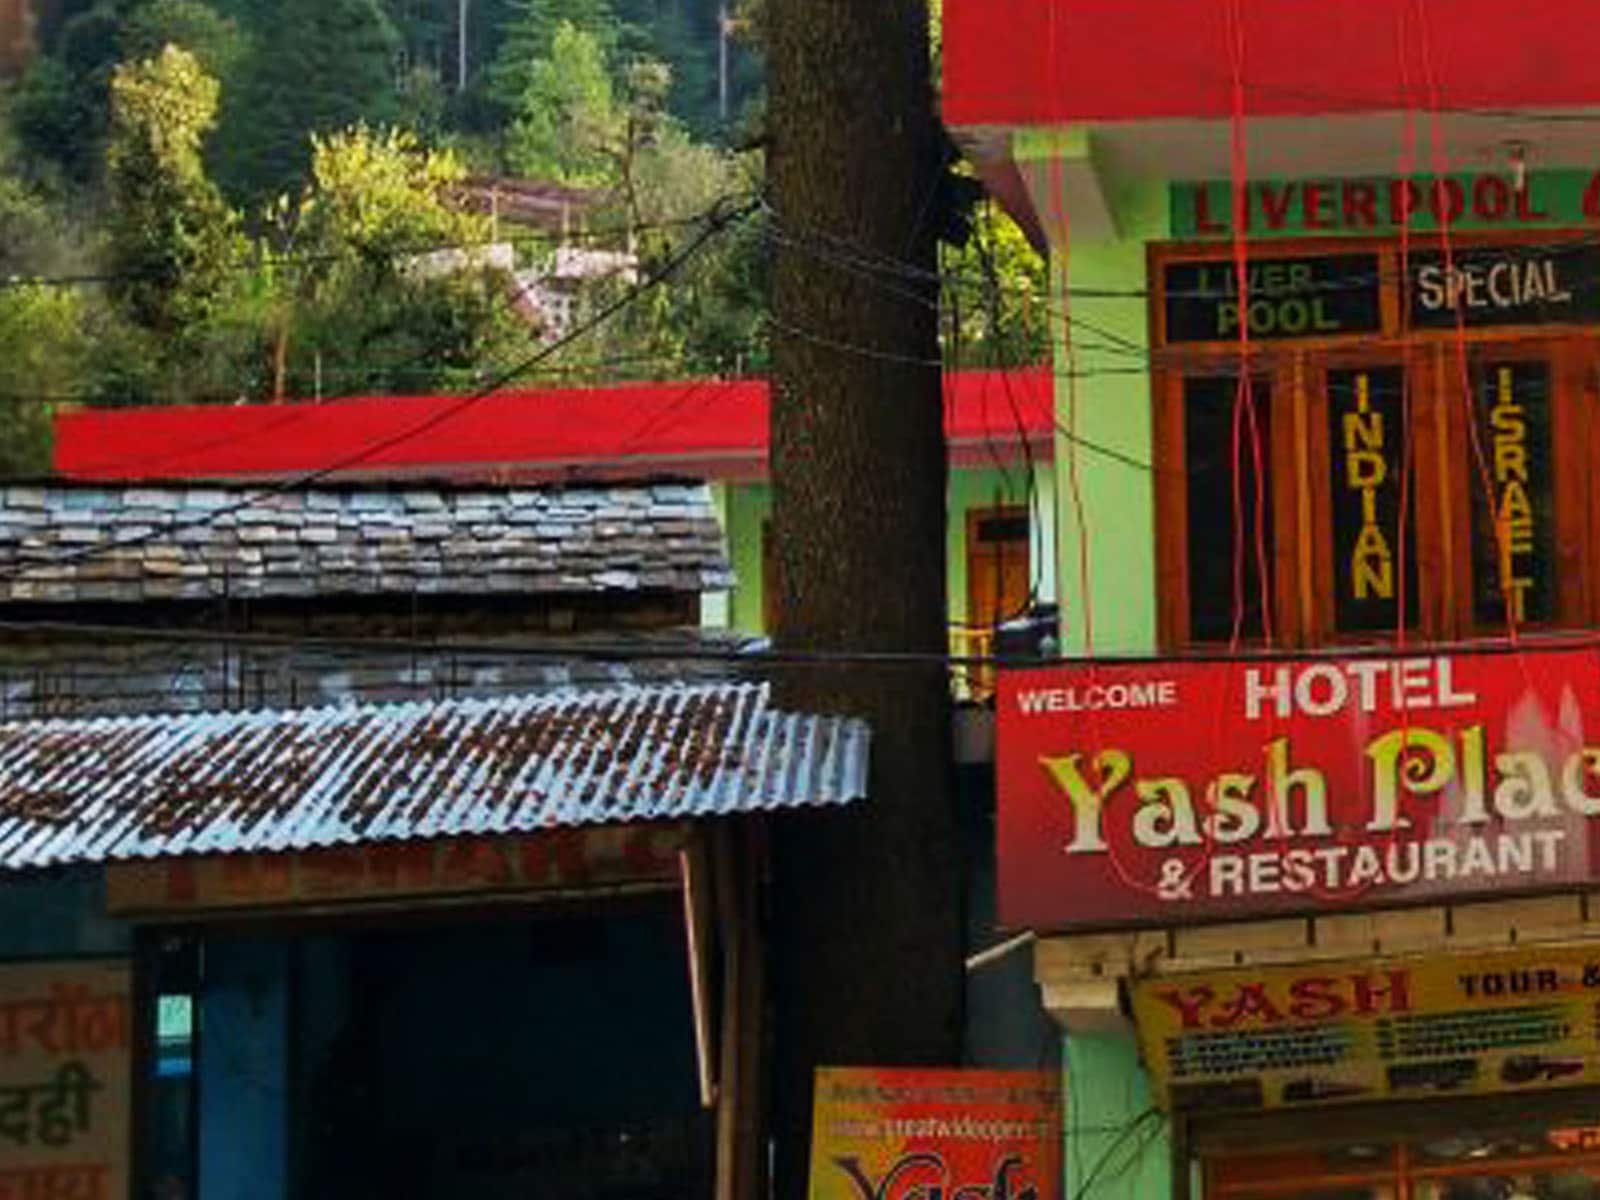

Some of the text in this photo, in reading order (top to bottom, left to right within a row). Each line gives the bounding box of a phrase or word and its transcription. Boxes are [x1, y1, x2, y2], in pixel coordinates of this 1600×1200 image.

[1195, 167, 1548, 230] LIVERPOOL
[1418, 259, 1572, 310] SPECIAL
[1342, 373, 1394, 599] INDIAN
[1016, 681, 1179, 715] WELCOME
[1244, 656, 1477, 720] HOTEL
[1039, 737, 1333, 855] Yash
[1157, 830, 1567, 900] & RESTAURANT
[1156, 972, 1413, 1031] YASH
[1457, 970, 1559, 997] TOUR
